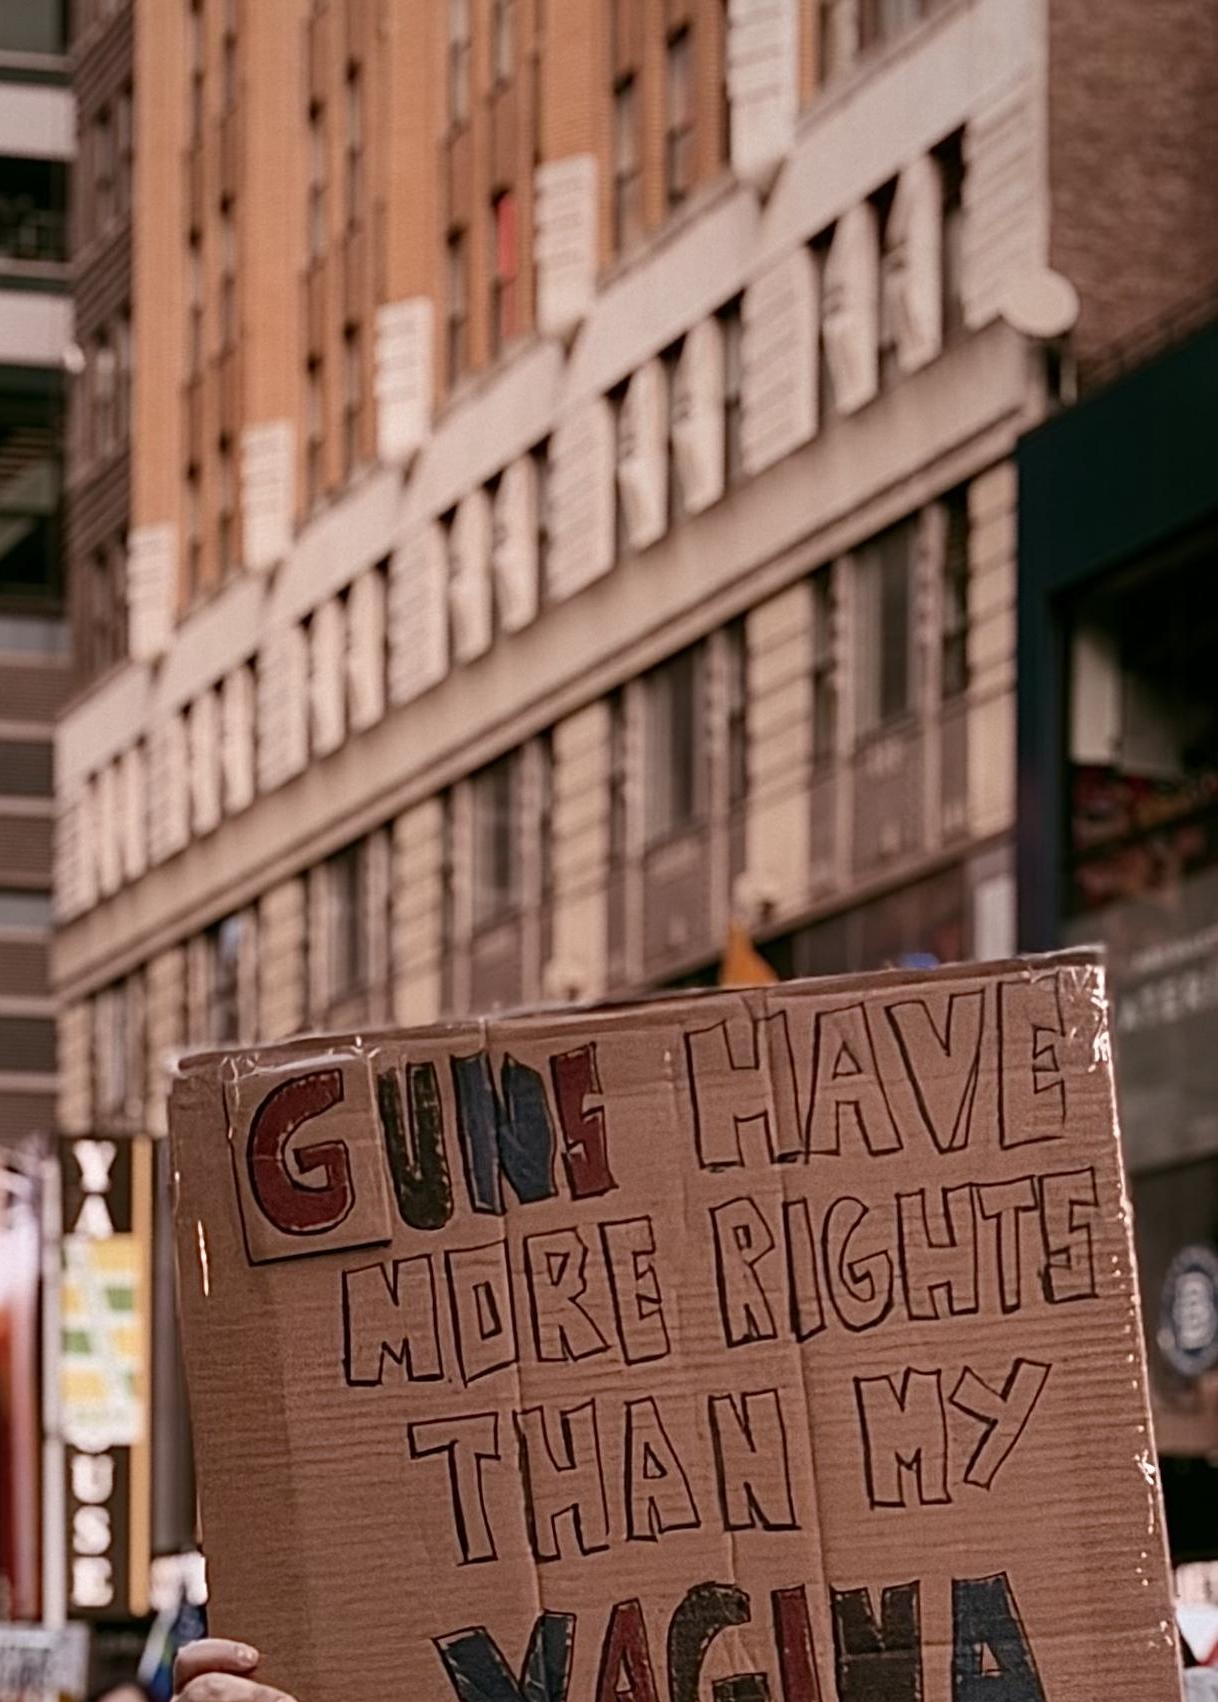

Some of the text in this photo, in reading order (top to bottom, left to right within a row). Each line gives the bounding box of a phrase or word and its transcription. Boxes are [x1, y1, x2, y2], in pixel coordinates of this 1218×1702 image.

[247, 971, 1067, 1236] GUNS HAVE
[339, 1216, 672, 1389] MORE
[708, 1165, 1100, 1347] RIGHTS
[407, 1357, 1052, 1566] THAN MY
